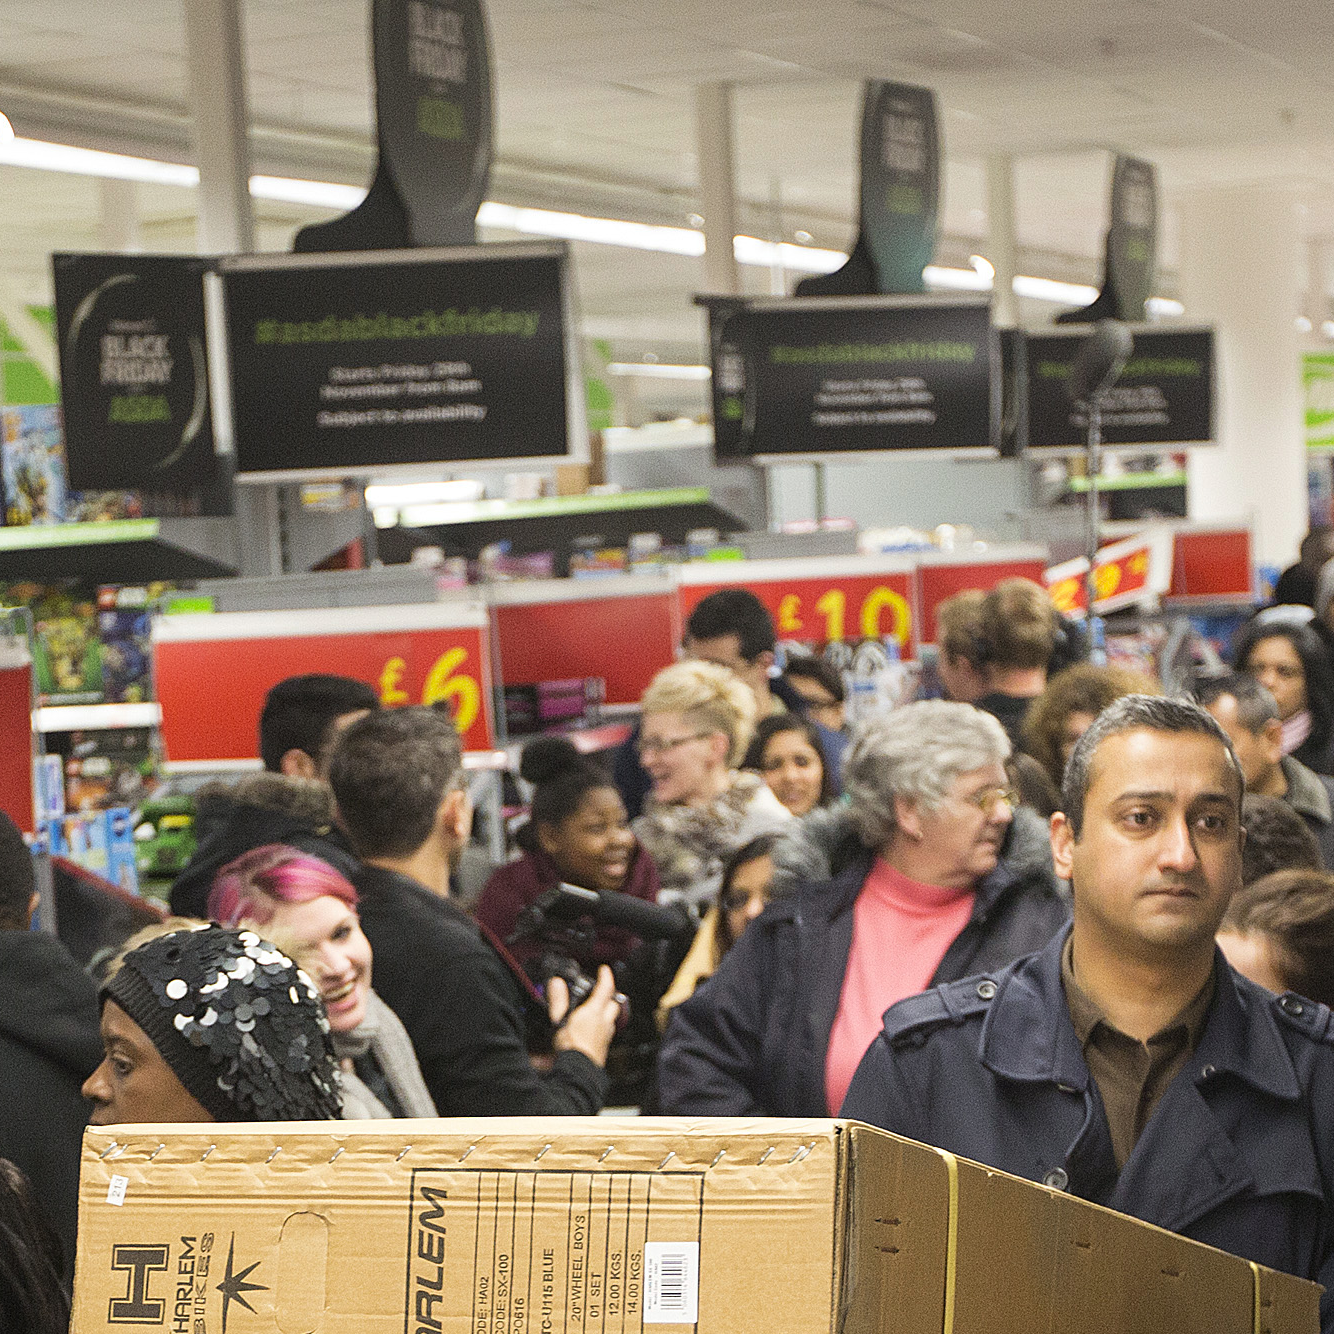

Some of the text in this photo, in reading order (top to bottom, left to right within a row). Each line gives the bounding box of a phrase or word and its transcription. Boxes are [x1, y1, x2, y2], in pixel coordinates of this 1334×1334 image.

[101, 334, 168, 359] BLACK
[100, 358, 173, 385] FRIDAY
[778, 585, 912, 648] £10
[379, 646, 480, 734] £6
[111, 1177, 124, 1198] 213
[573, 1215, 585, 1250] BOYS
[497, 1253, 509, 1297] SX-100
[543, 1248, 554, 1282] BLUE
[611, 1249, 622, 1280] KGS.
[630, 1249, 641, 1280] KGS.
[108, 1244, 170, 1325] H
[173, 1235, 197, 1334] HARLEM
[478, 1276, 490, 1307] HA02
[591, 1271, 601, 1298] SET
[609, 1282, 620, 1316] 12.00
[628, 1282, 639, 1316] 14.00
[590, 1301, 600, 1318] 01
